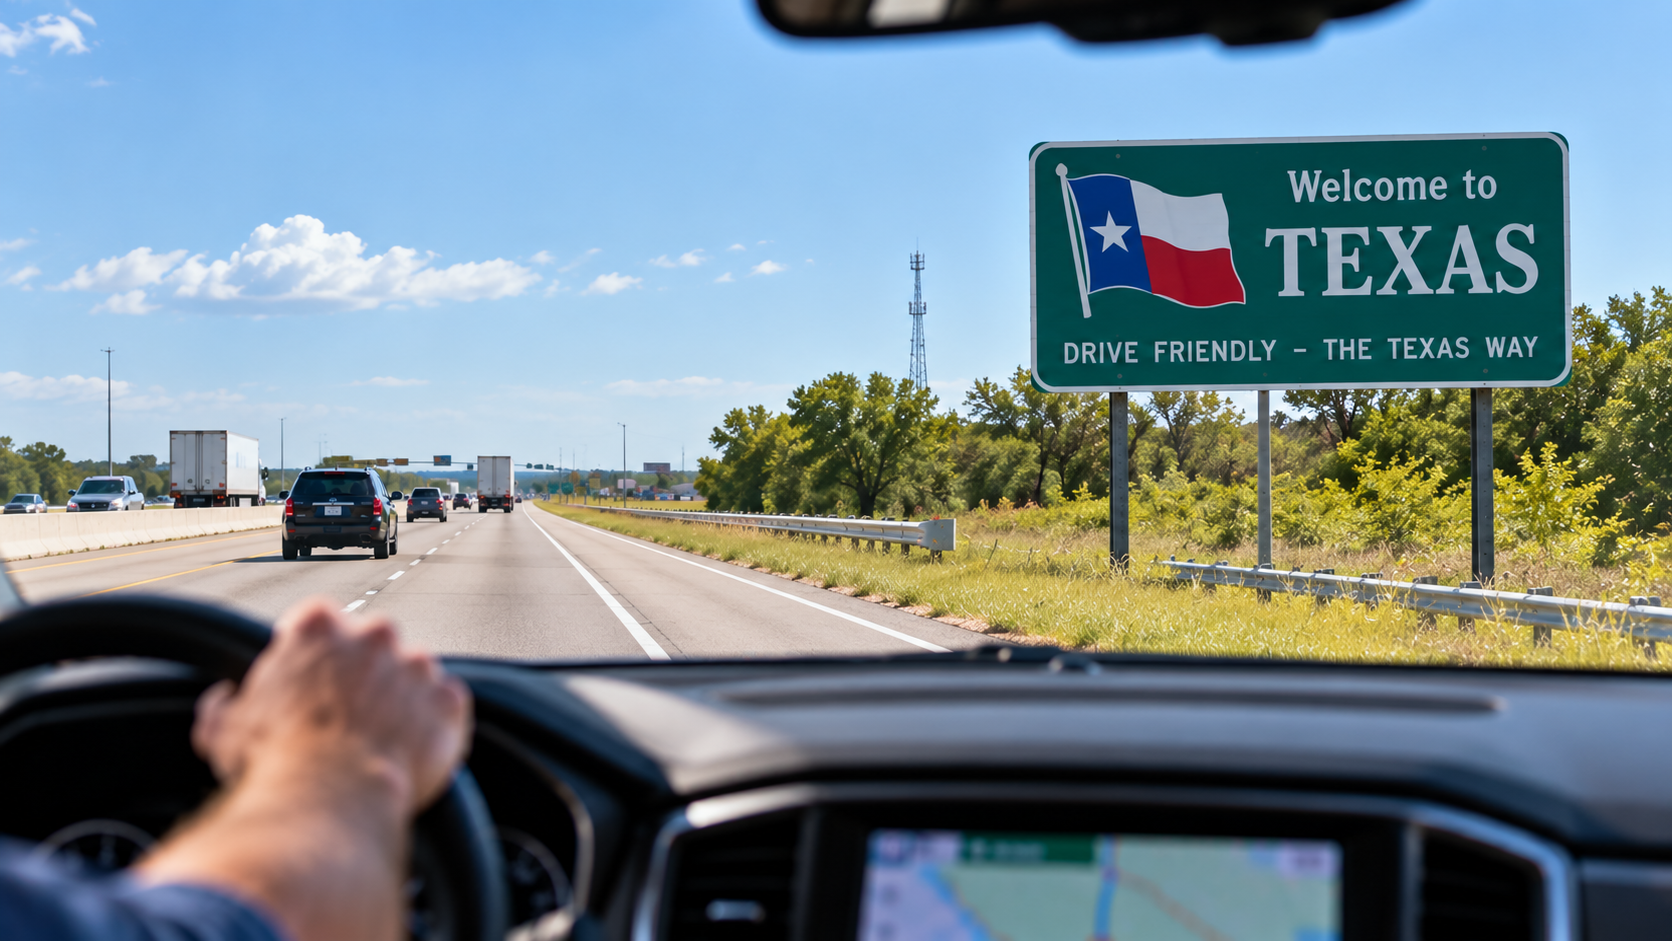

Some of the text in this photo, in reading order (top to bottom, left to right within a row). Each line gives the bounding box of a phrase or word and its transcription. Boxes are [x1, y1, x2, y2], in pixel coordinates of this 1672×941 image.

[1287, 168, 1497, 203] Welcome to
[1264, 223, 1539, 297] TEXAS
[1064, 341, 1139, 364] DRIVE
[1154, 339, 1277, 363] FRIENDLY
[1322, 338, 1372, 361] THE
[1387, 336, 1470, 360] TEXAS
[1485, 336, 1539, 358] WAY
